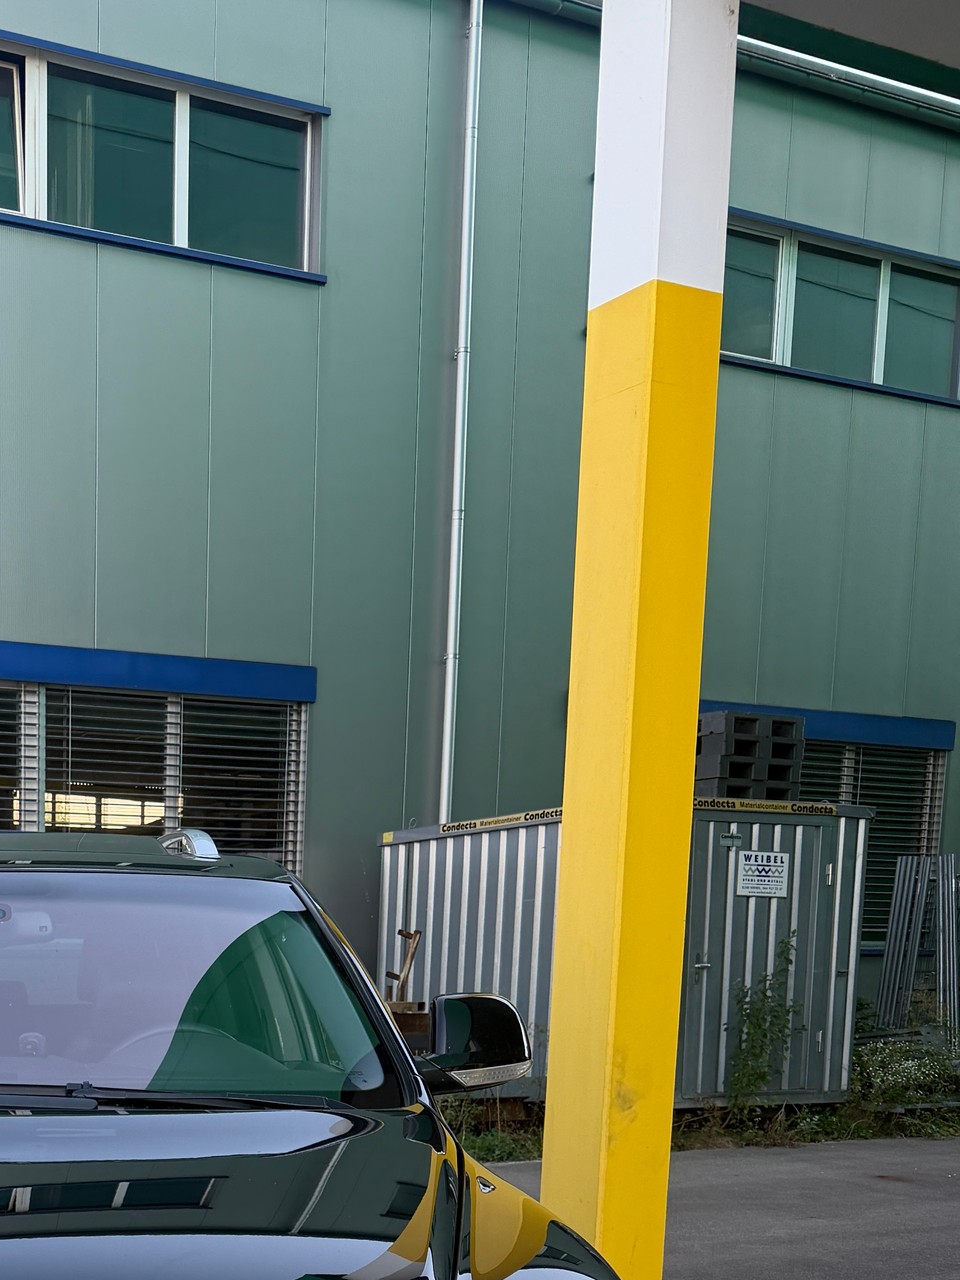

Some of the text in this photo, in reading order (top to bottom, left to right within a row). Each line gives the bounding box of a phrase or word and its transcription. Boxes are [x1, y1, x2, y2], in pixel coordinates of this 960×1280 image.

[693, 798, 834, 815] Condecta Materialcontainer Condecta
[441, 808, 563, 833] Condecta Materialcontainer Condecta
[743, 853, 785, 864] WEIBEL
